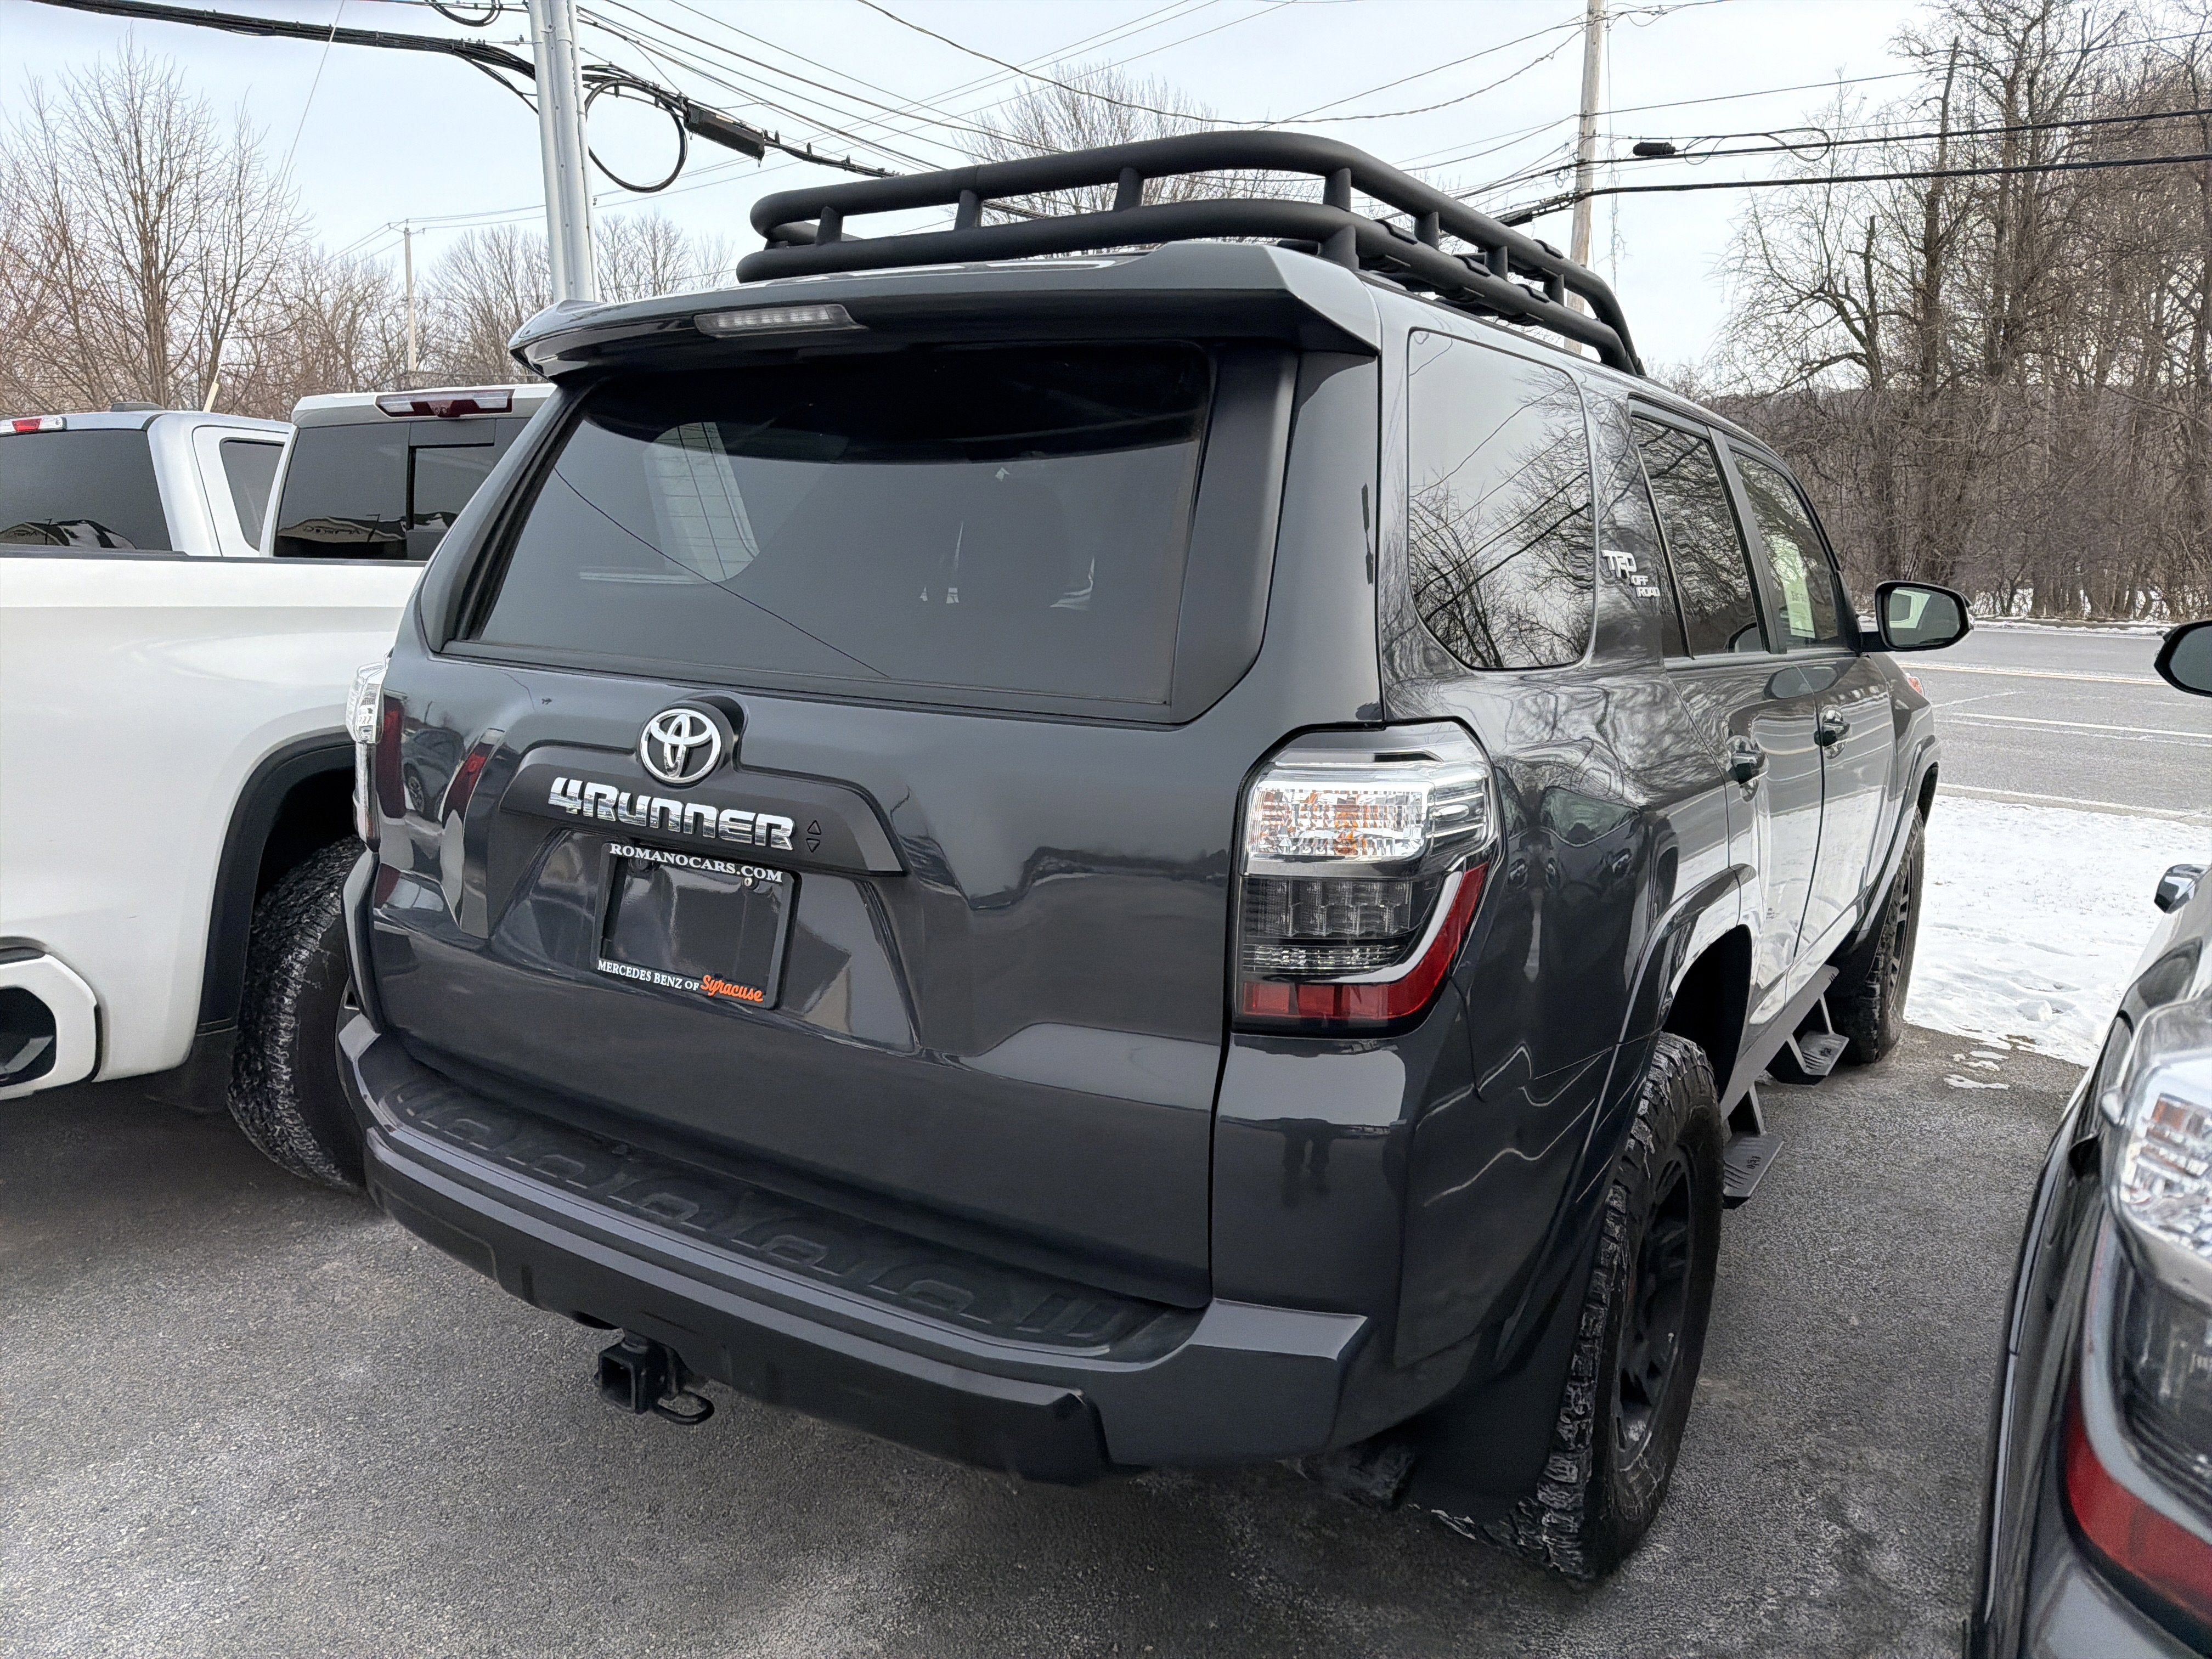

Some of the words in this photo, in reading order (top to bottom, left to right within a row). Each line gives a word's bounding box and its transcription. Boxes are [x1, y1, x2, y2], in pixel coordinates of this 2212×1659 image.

[1600, 550, 1637, 578] TRD
[1631, 575, 1649, 585] OFF
[1635, 586, 1661, 597] ROAD
[548, 777, 794, 850] 4RUNNER
[609, 843, 783, 883] ROMANOCARS.COM
[597, 960, 652, 982] MERCEDES
[653, 973, 682, 989] BENZ
[684, 980, 699, 991] OF
[701, 974, 764, 1003] Syracuse
